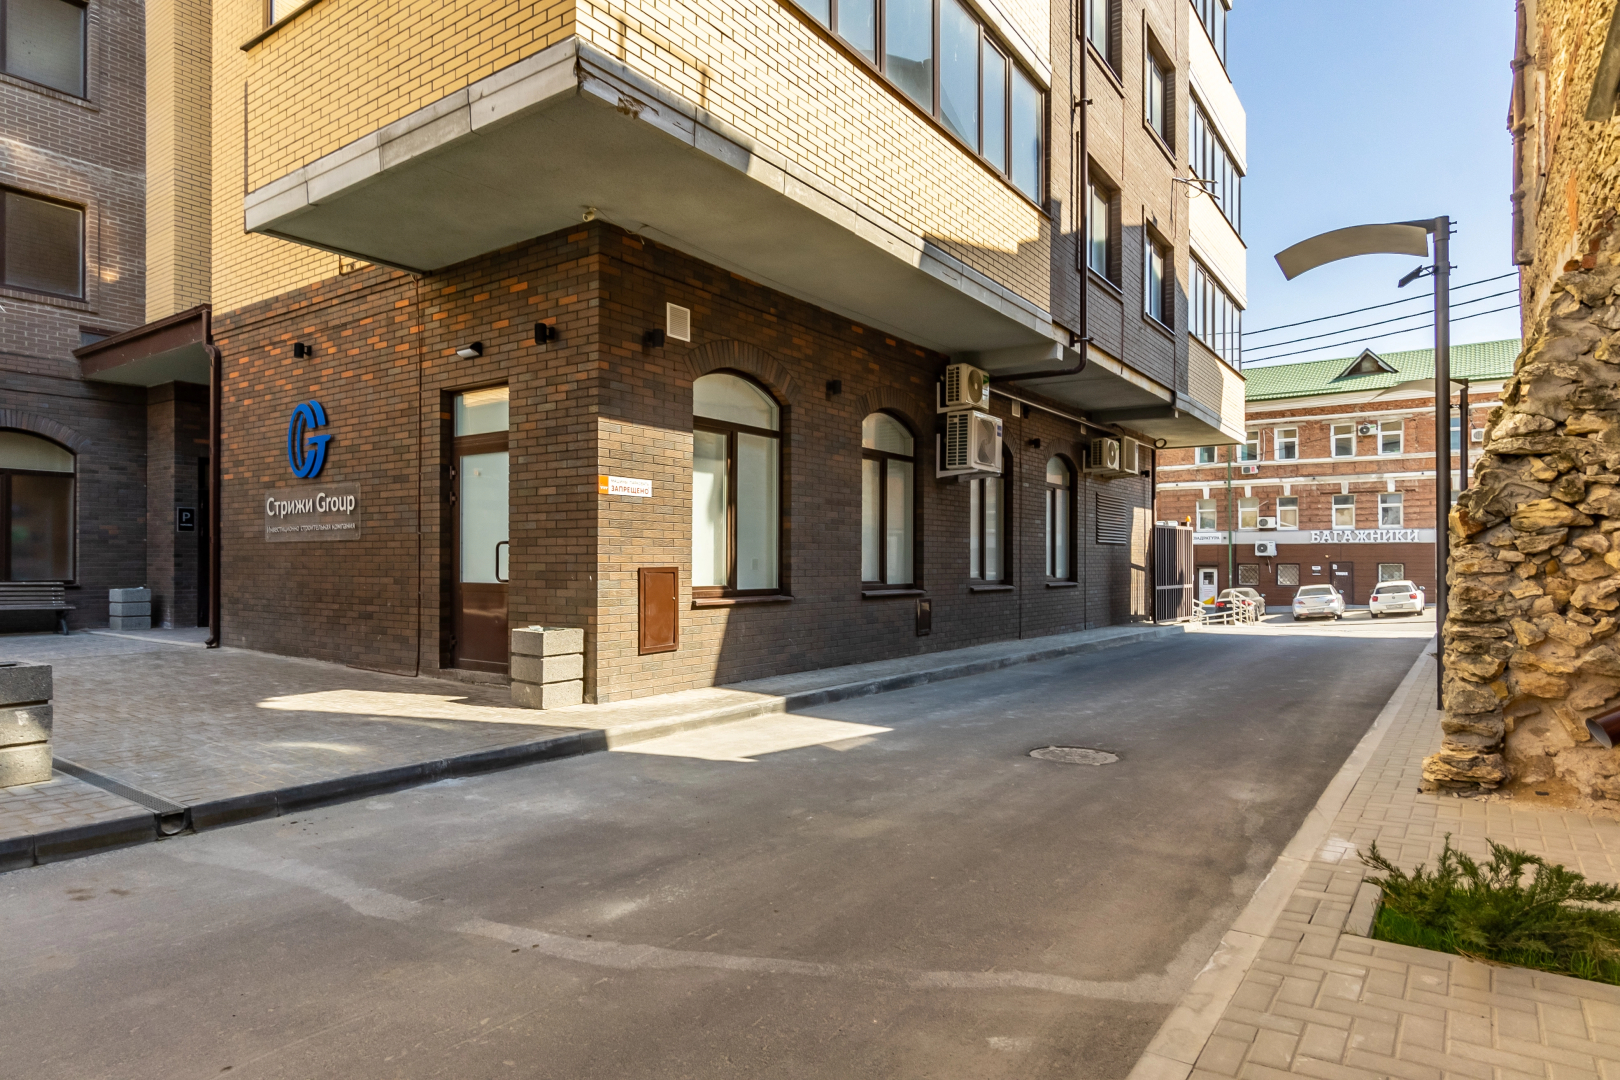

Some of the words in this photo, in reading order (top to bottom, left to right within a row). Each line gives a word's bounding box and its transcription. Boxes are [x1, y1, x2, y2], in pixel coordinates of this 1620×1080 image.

[611, 485, 650, 494] ЗАПРЕЩЕНО
[266, 497, 313, 519] Стрижи
[316, 492, 356, 515] Group
[182, 511, 191, 522] P
[1310, 529, 1420, 543] БАГАЖНИКИ
